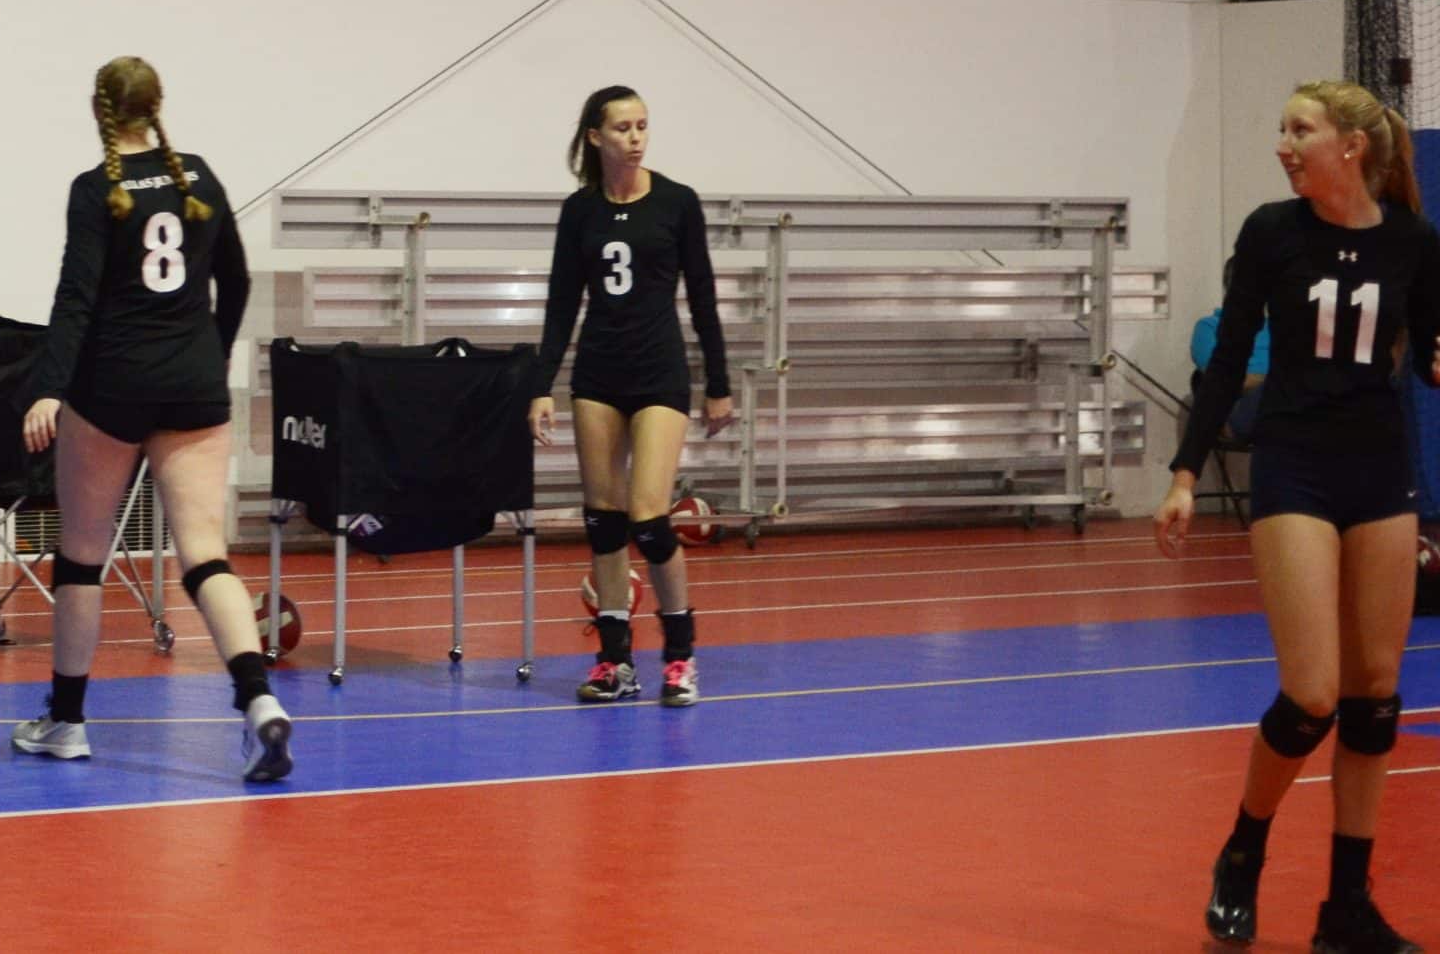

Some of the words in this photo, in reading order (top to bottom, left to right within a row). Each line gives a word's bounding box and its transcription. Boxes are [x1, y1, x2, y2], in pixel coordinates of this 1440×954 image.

[142, 212, 186, 293] 8
[602, 241, 633, 295] 3
[1308, 278, 1380, 364] 11
